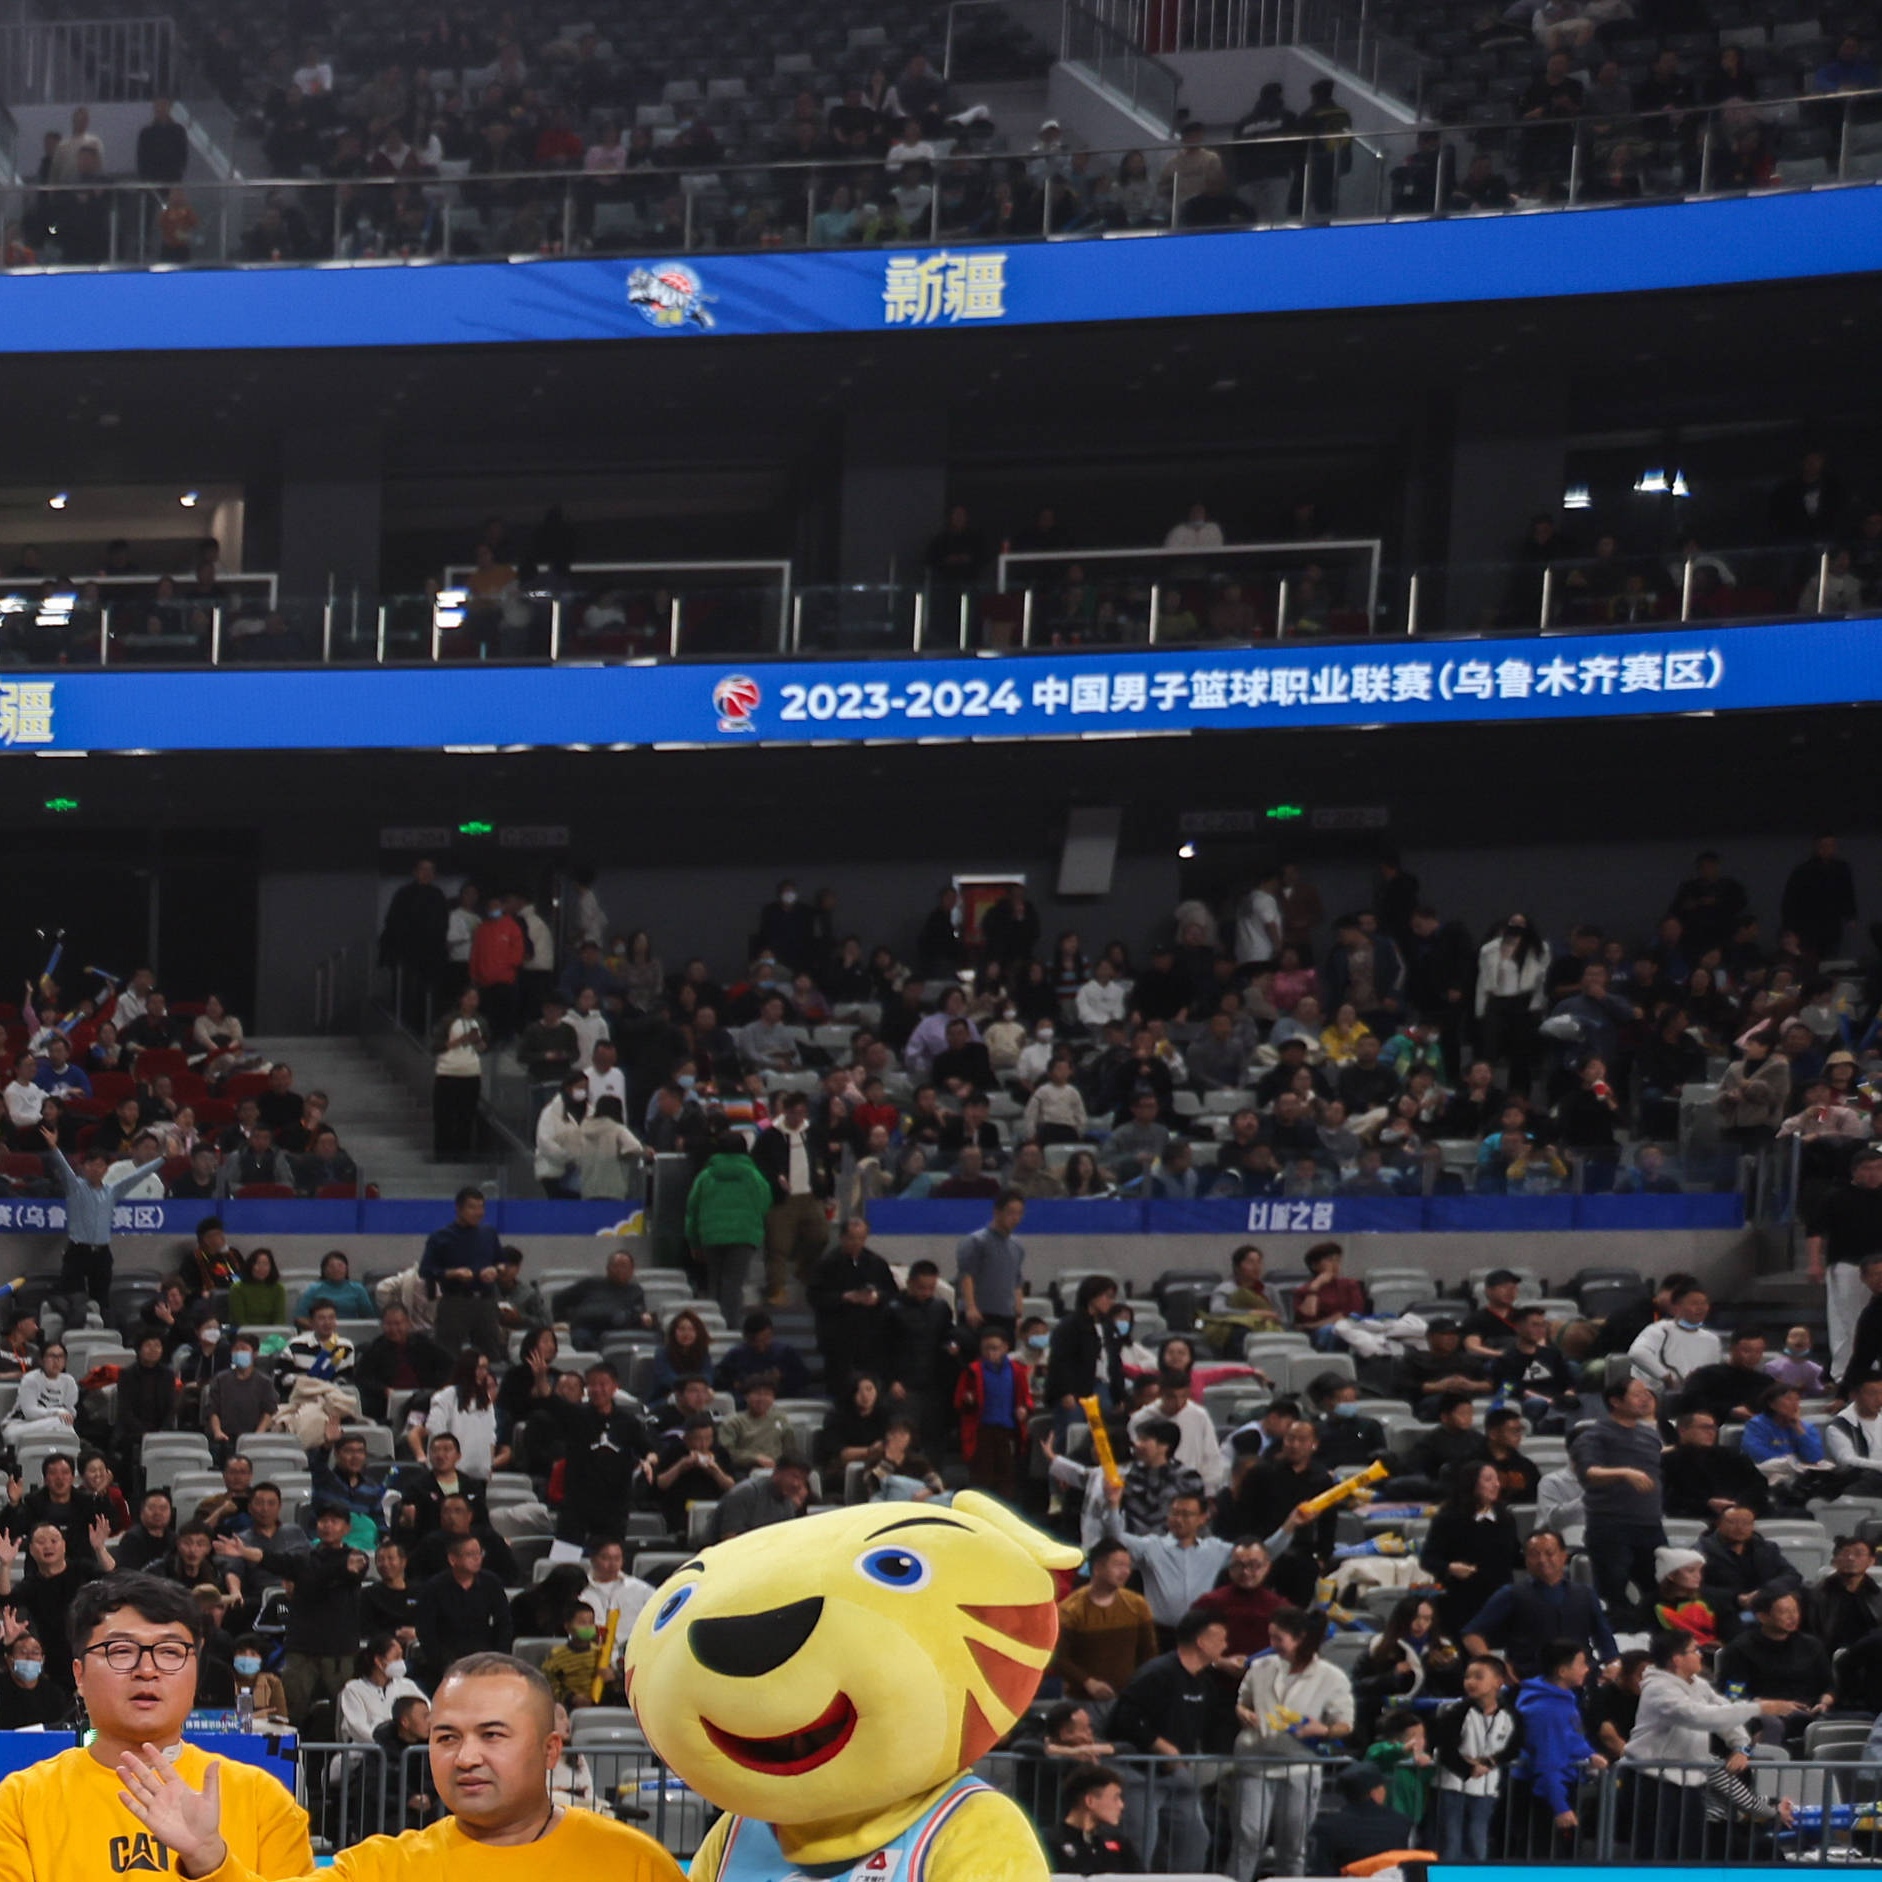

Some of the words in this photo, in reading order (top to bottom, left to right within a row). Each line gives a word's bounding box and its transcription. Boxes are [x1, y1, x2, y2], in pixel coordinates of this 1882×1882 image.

[882, 251, 1009, 325] 新疆
[779, 679, 1023, 722] 2023-2024
[1031, 649, 1724, 716] 中国男子篮球职业联赛(乌鲁木齐赛区)
